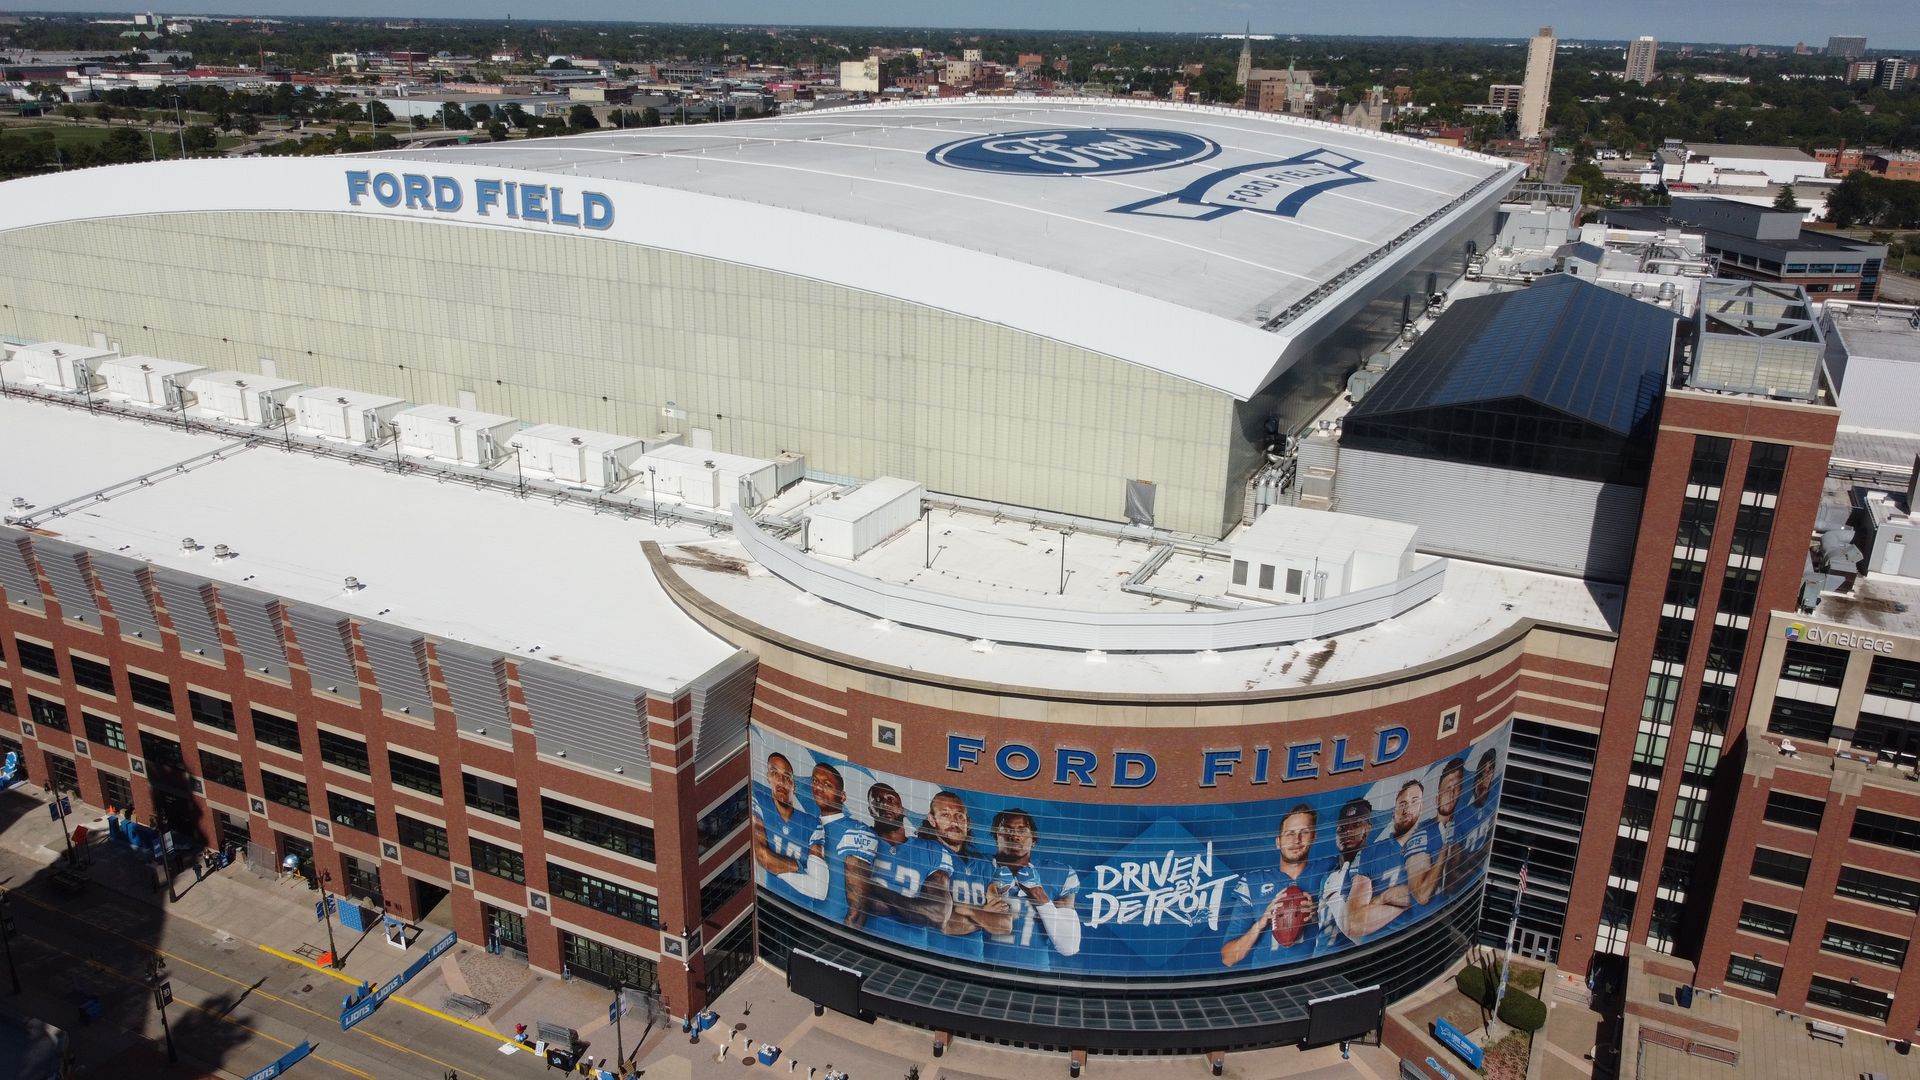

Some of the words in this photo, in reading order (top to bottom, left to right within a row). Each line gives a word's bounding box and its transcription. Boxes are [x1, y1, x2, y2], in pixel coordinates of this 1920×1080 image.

[982, 134, 1181, 167] Ford
[1226, 180, 1279, 204] FORD
[1264, 168, 1335, 182] FIELD
[345, 169, 463, 213] FORD
[474, 178, 615, 231] FIELD
[1806, 627, 1894, 653] dynatrace
[946, 731, 1158, 788] FORD
[1199, 725, 1410, 788] FIELD
[853, 837, 871, 848] WCF
[1095, 840, 1212, 892] DRIVEN
[1175, 876, 1200, 895] BY
[1083, 874, 1239, 931] DETROIT
[432, 934, 454, 956] LIONS
[375, 978, 399, 1001] LIONS
[345, 1003, 370, 1025] LIONS
[247, 1064, 275, 1080] IONS
